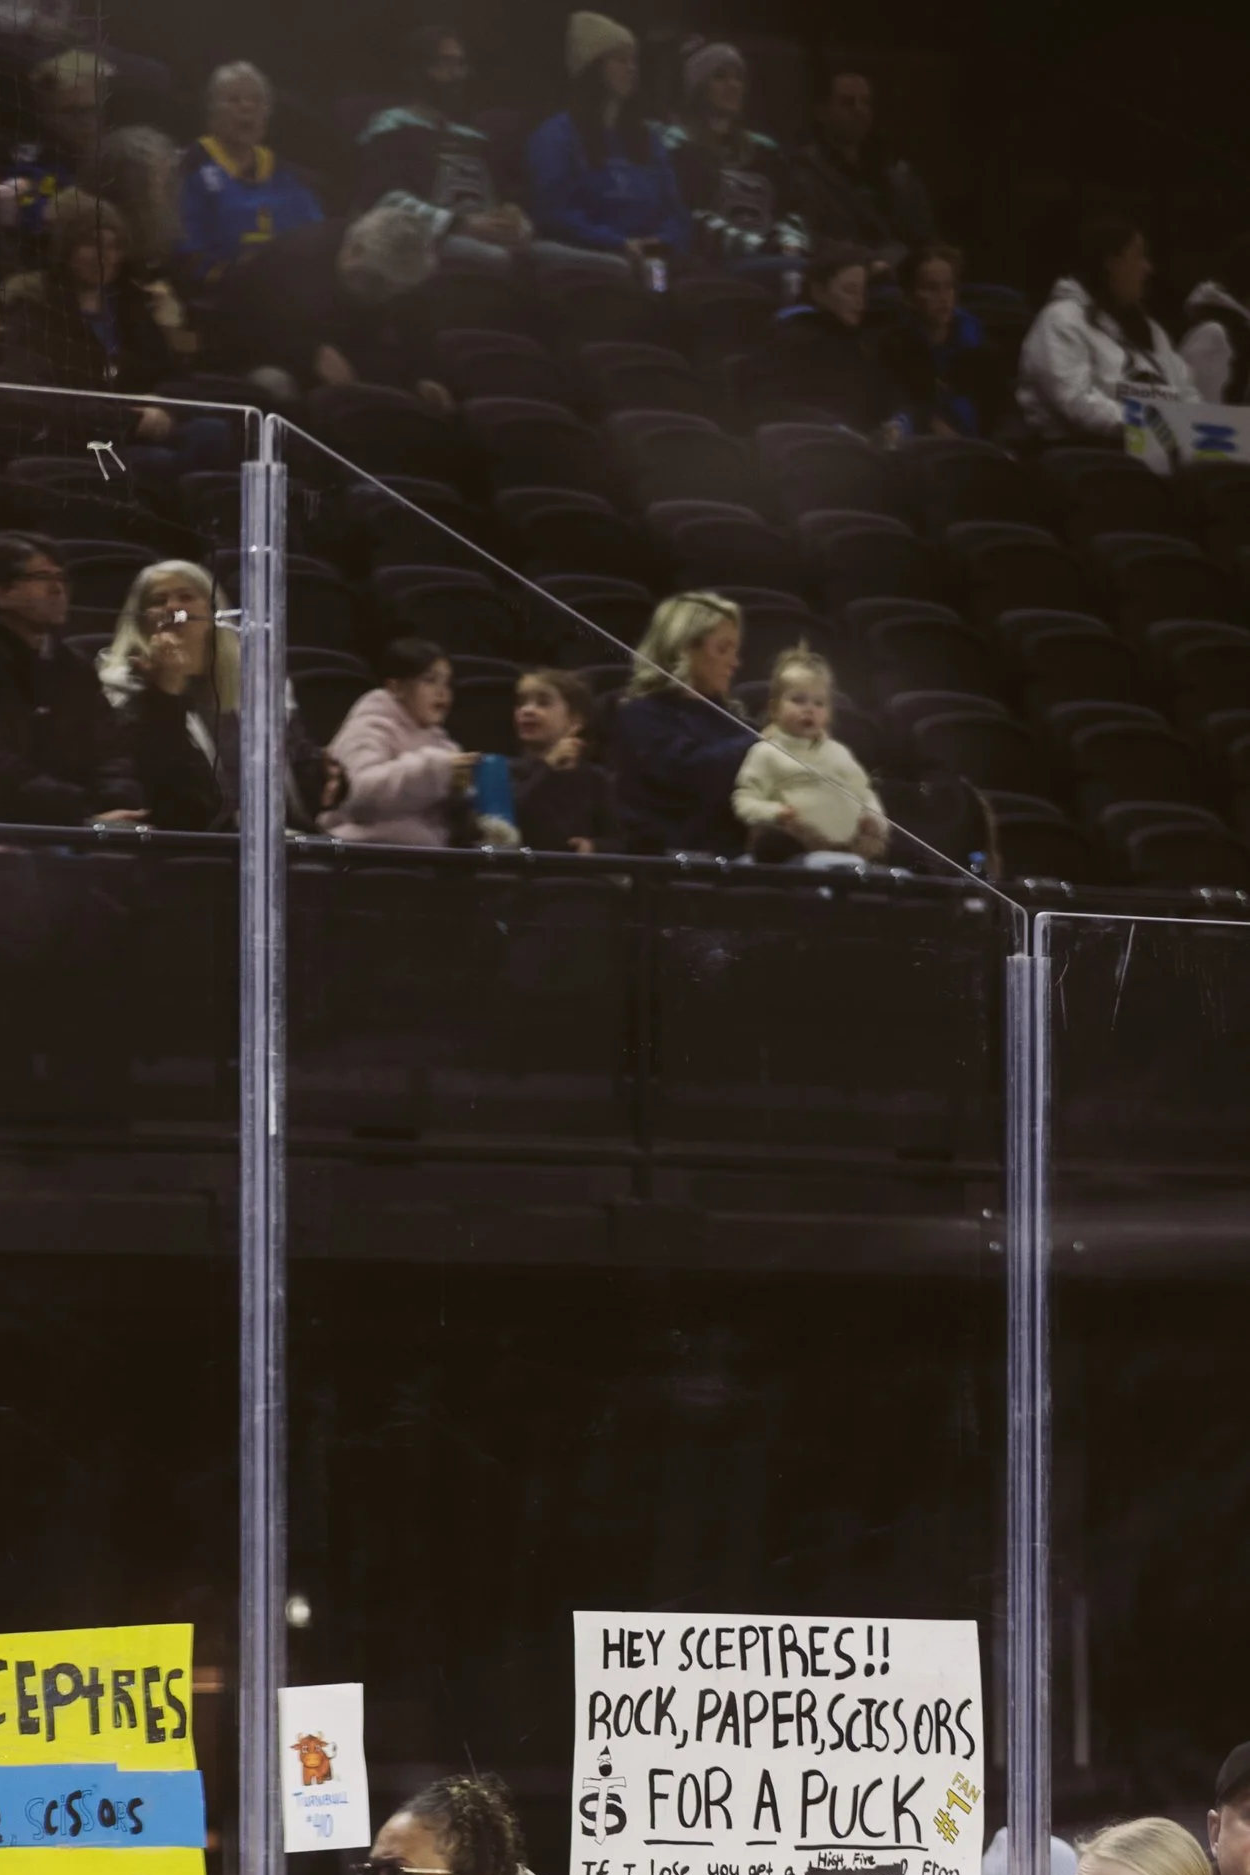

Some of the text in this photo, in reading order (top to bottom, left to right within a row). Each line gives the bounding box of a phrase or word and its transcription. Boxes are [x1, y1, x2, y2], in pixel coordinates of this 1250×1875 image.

[602, 1624, 890, 1680] HEY SCEPTRES!!
[649, 1766, 925, 1844] FOR A PUCK
